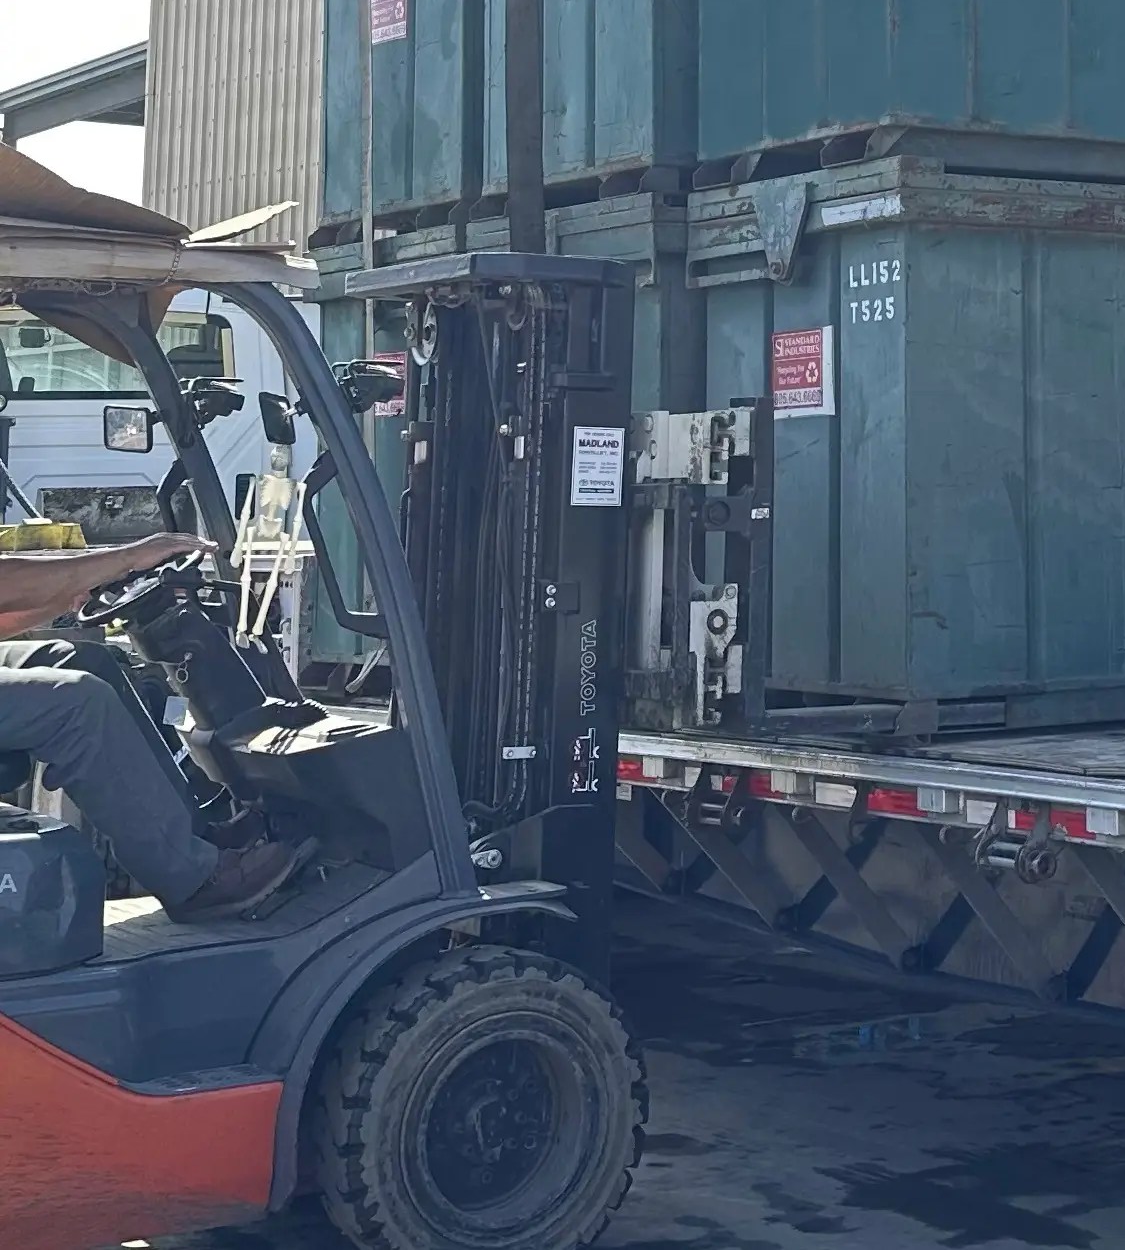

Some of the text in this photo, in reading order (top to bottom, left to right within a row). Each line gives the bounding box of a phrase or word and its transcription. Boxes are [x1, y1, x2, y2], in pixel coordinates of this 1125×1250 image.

[849, 259, 901, 288] LL152
[850, 296, 895, 324] T525
[785, 334, 821, 347] STANDARD
[785, 344, 820, 356] INDUSTRIES
[578, 439, 620, 449] MADLAND
[580, 619, 597, 716] TOYOTA
